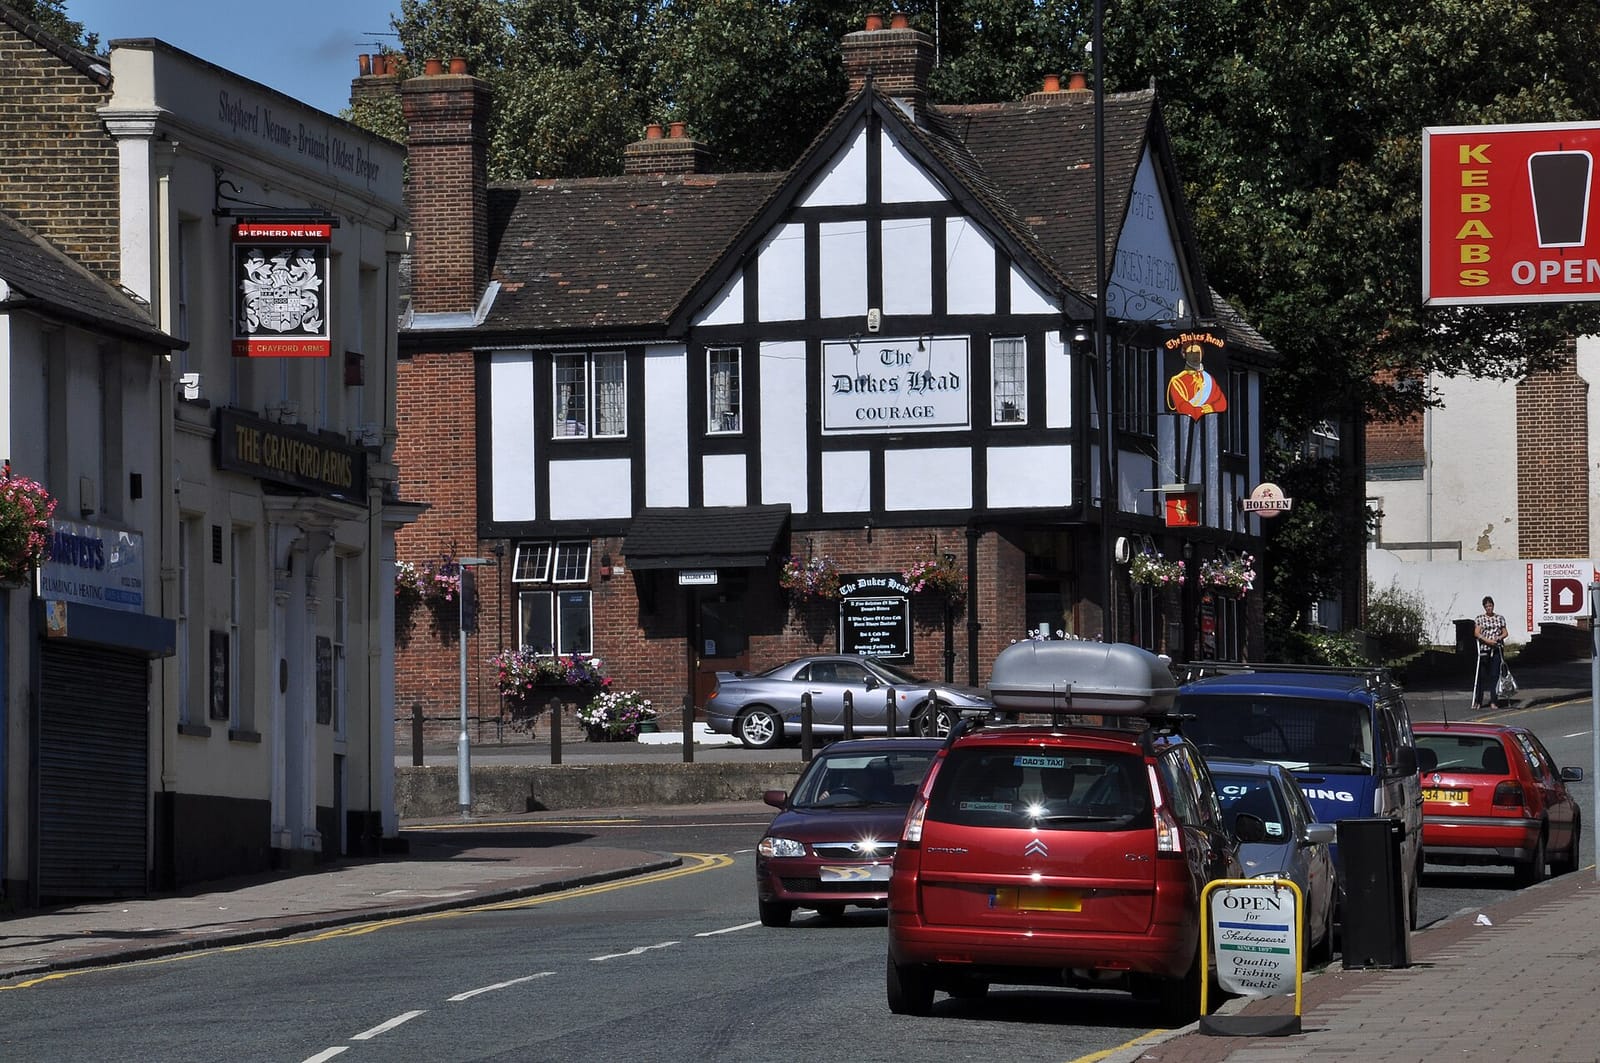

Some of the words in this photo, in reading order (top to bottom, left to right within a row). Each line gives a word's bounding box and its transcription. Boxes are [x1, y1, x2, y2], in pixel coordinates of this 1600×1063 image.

[218, 90, 259, 134] Shepherd
[262, 108, 292, 148] Neame
[332, 137, 354, 171] Oldest
[1456, 144, 1494, 286] KEBABS
[1165, 338, 1180, 350] The
[880, 349, 912, 366] The
[832, 373, 900, 394] Dukes
[907, 371, 960, 395] Head
[856, 406, 934, 420] COURAGE
[236, 424, 260, 464] THE
[264, 432, 320, 480] CRAYFORD
[322, 450, 352, 488] ARMS
[1246, 500, 1290, 509] HOLSTEN
[42, 576, 72, 596] PLUMBING
[78, 584, 102, 600] HEATING
[839, 584, 856, 595] The
[857, 577, 887, 588] Dukes
[888, 578, 910, 594] Head
[1223, 896, 1281, 910] OPEN
[1244, 912, 1260, 921] for
[1222, 930, 1286, 944] Shakespeare
[1233, 956, 1280, 969] Quality
[1234, 967, 1281, 980] Fishing
[1238, 978, 1278, 989] Tackle
